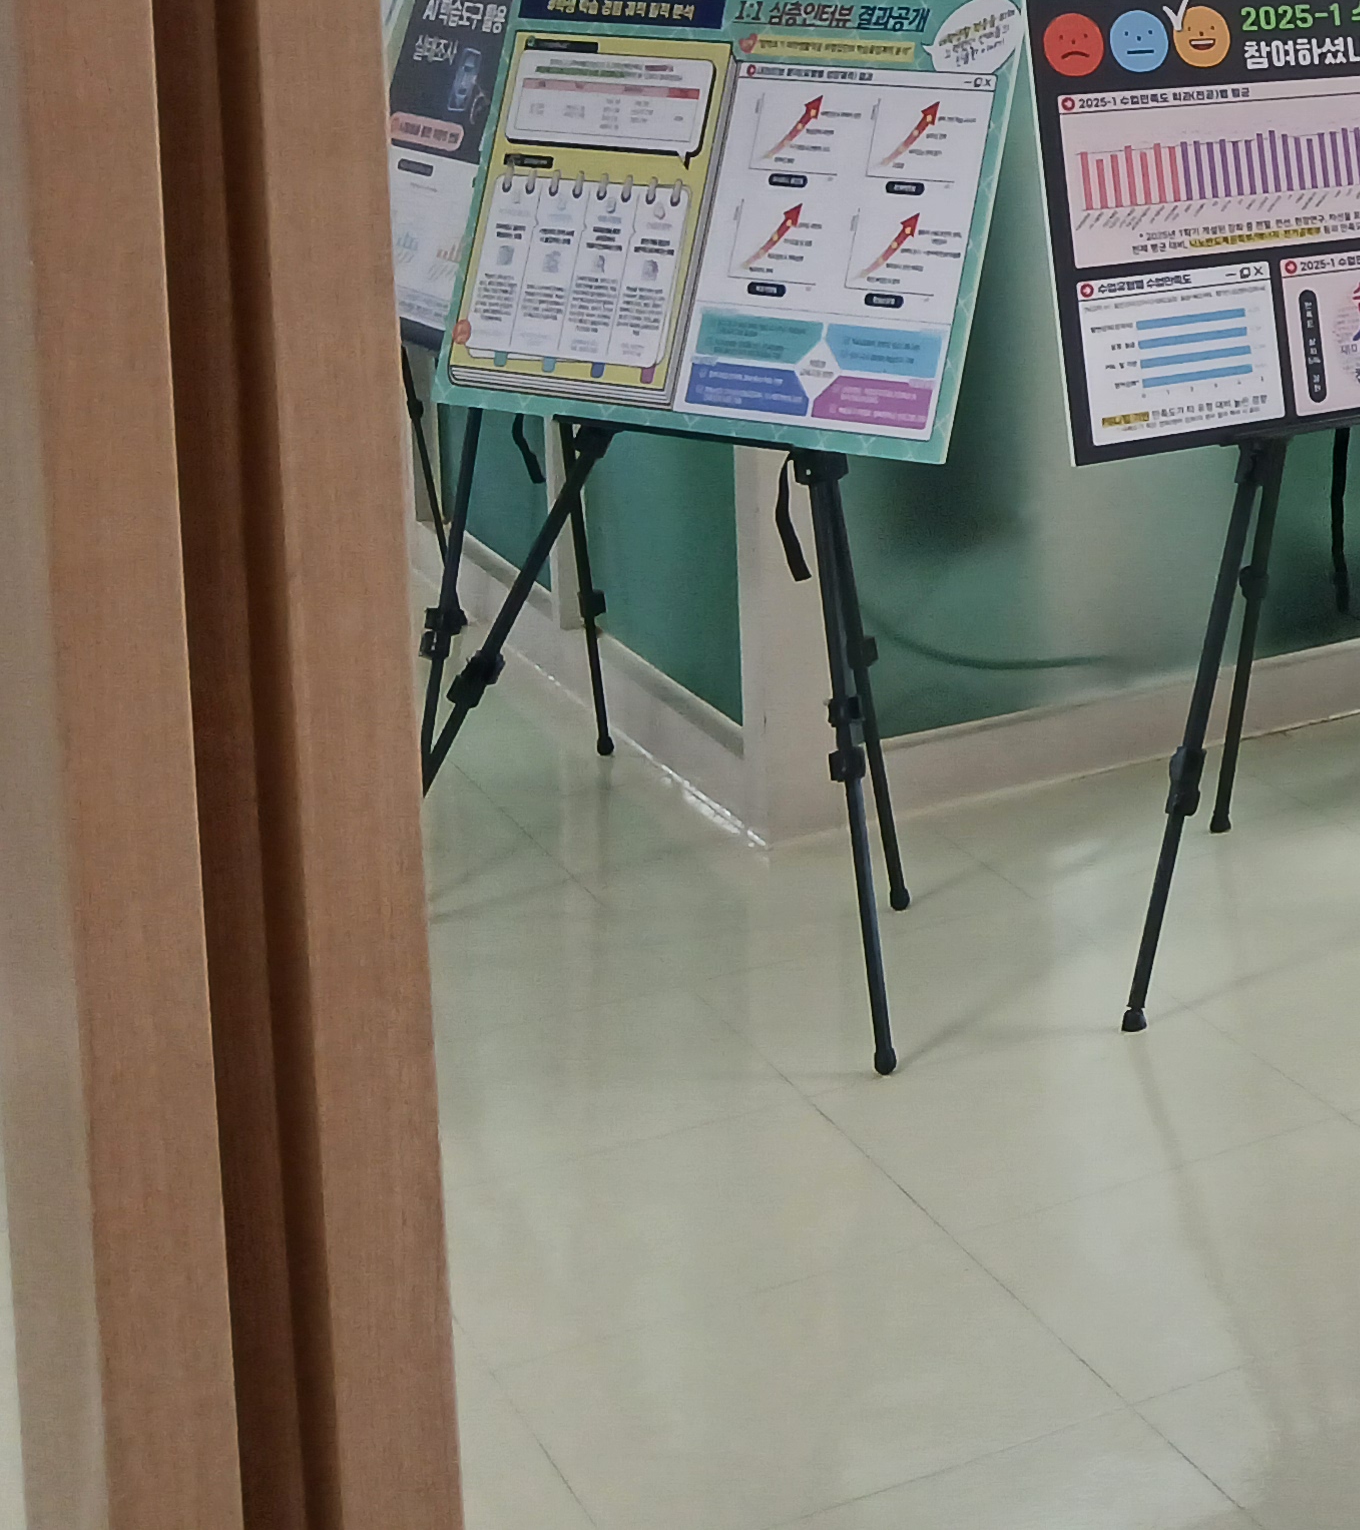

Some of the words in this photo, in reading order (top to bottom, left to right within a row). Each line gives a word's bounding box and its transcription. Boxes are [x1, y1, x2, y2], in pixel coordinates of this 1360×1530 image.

[735, 0, 763, 21] 1:1
[768, 1, 855, 28] 심층인터뷰
[857, 5, 931, 33] 결과공개
[1241, 2, 1342, 32] 2025-1
[1078, 96, 1117, 110] 2025-1
[1301, 257, 1336, 271] 2025-1
